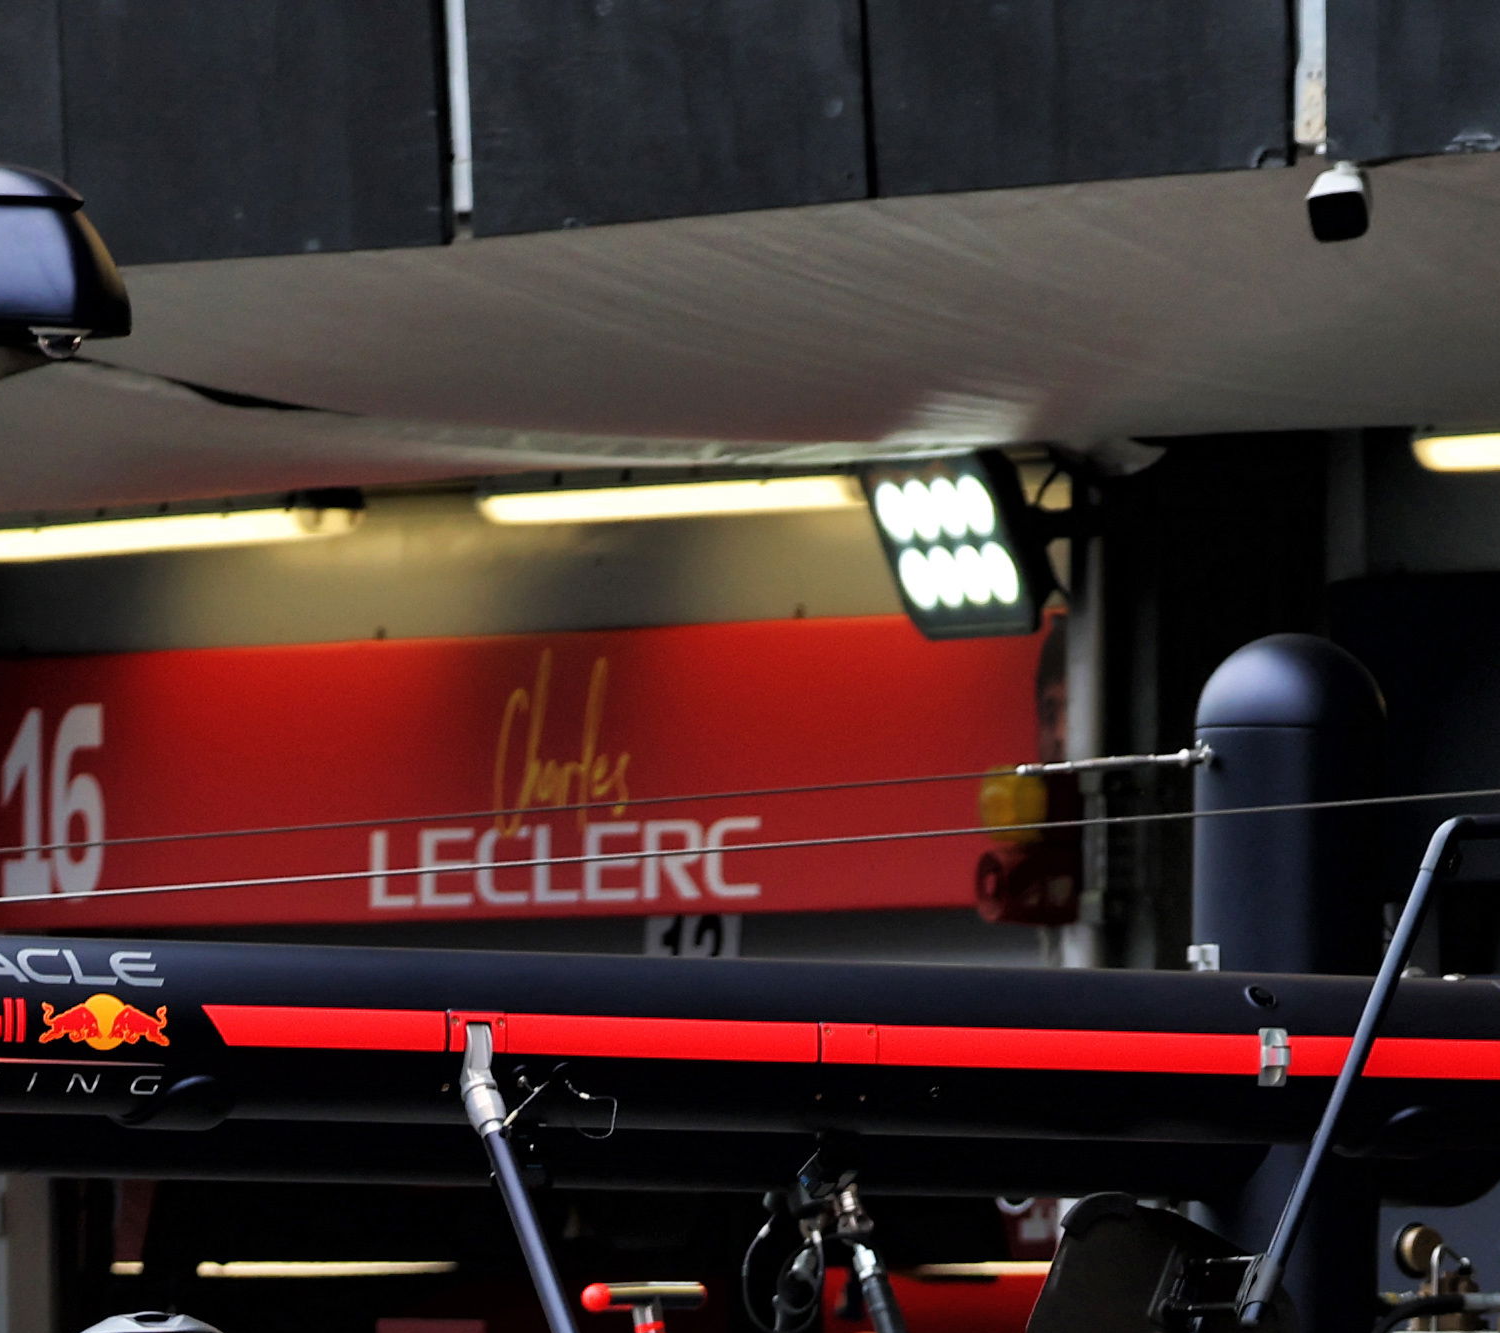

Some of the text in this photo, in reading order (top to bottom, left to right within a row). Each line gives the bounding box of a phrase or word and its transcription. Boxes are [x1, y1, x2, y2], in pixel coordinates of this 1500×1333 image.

[0, 703, 104, 901] 16
[495, 648, 630, 837] Charles
[370, 816, 762, 910] LECLERC
